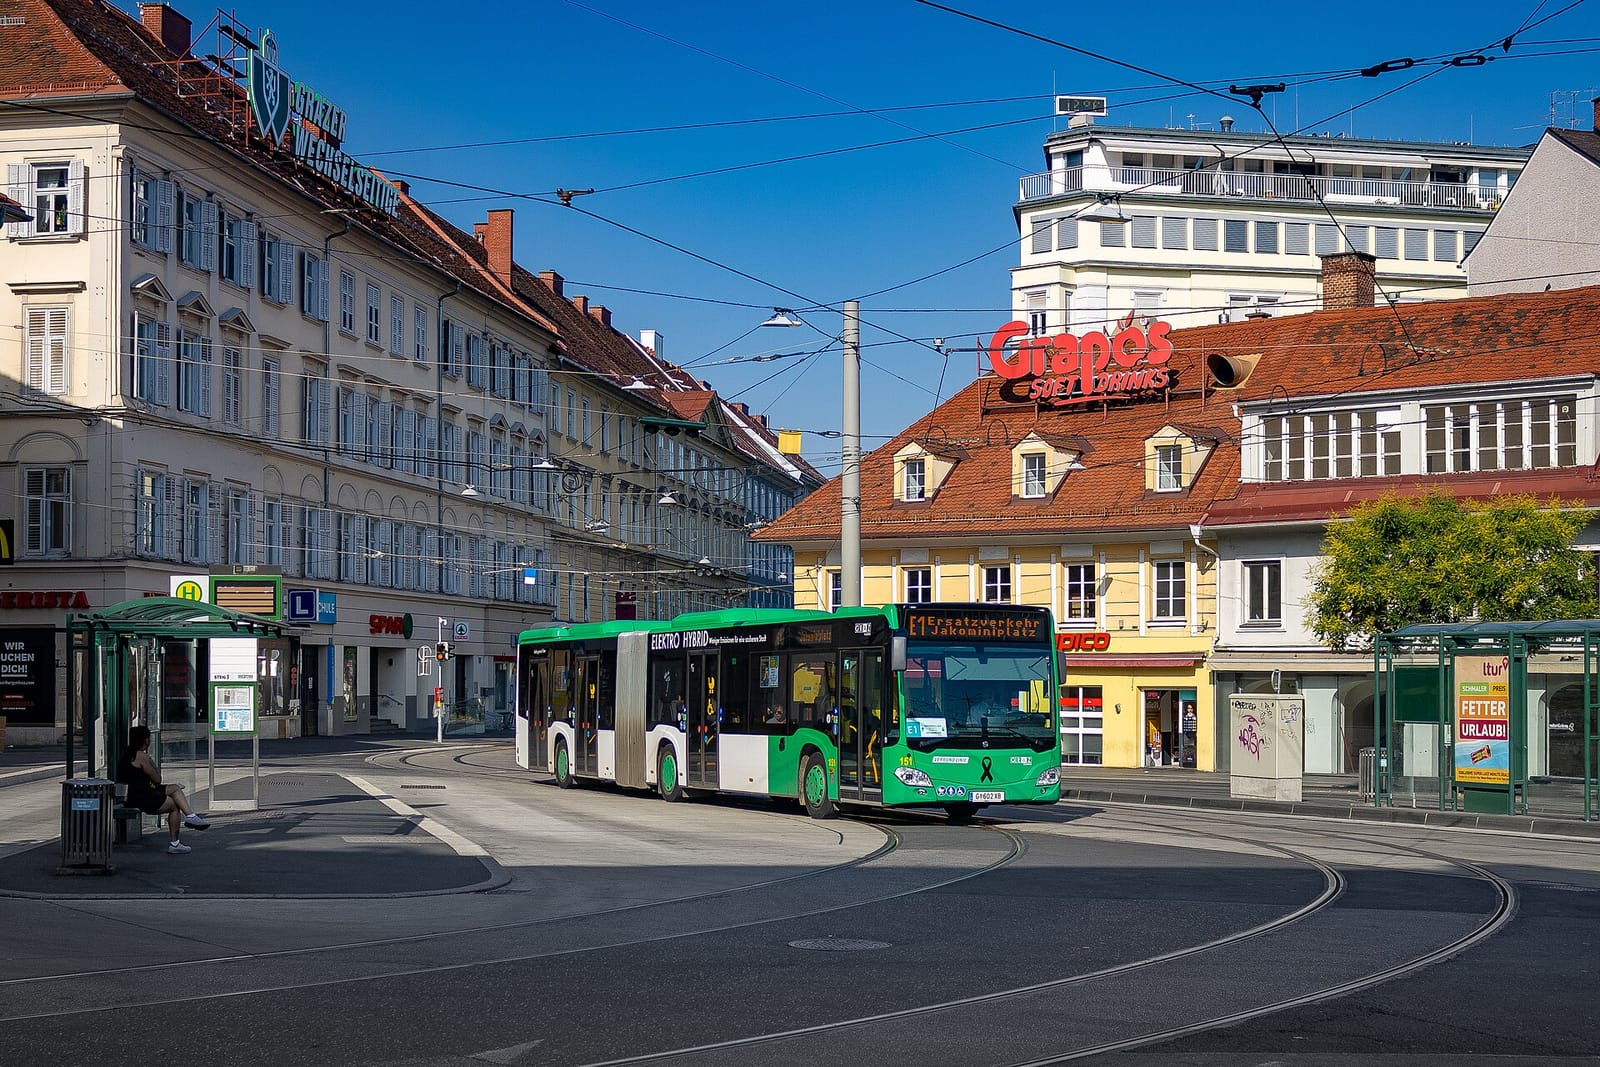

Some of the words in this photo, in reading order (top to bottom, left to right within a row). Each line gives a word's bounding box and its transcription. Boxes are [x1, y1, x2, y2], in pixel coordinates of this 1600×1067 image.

[295, 82, 348, 142] GRAZER
[295, 122, 400, 218] WECHSELSEITIGE
[1029, 375, 1078, 399] SOFT
[1093, 366, 1169, 393] DRINKS
[369, 614, 404, 634] SPAR
[909, 615, 925, 636] E1
[927, 616, 1041, 628] Ersatzverkehr
[931, 626, 1037, 638] Jakominiplatz
[4, 641, 25, 651] WIR
[651, 632, 680, 650] ELEKTRO
[682, 630, 709, 648] HYBRID
[1, 664, 28, 673] DICH!
[1483, 662, 1502, 676] ltur
[1461, 700, 1506, 716] FETTER
[907, 725, 917, 734] E1
[1461, 723, 1506, 737] URLAUB!
[900, 757, 913, 766] 151
